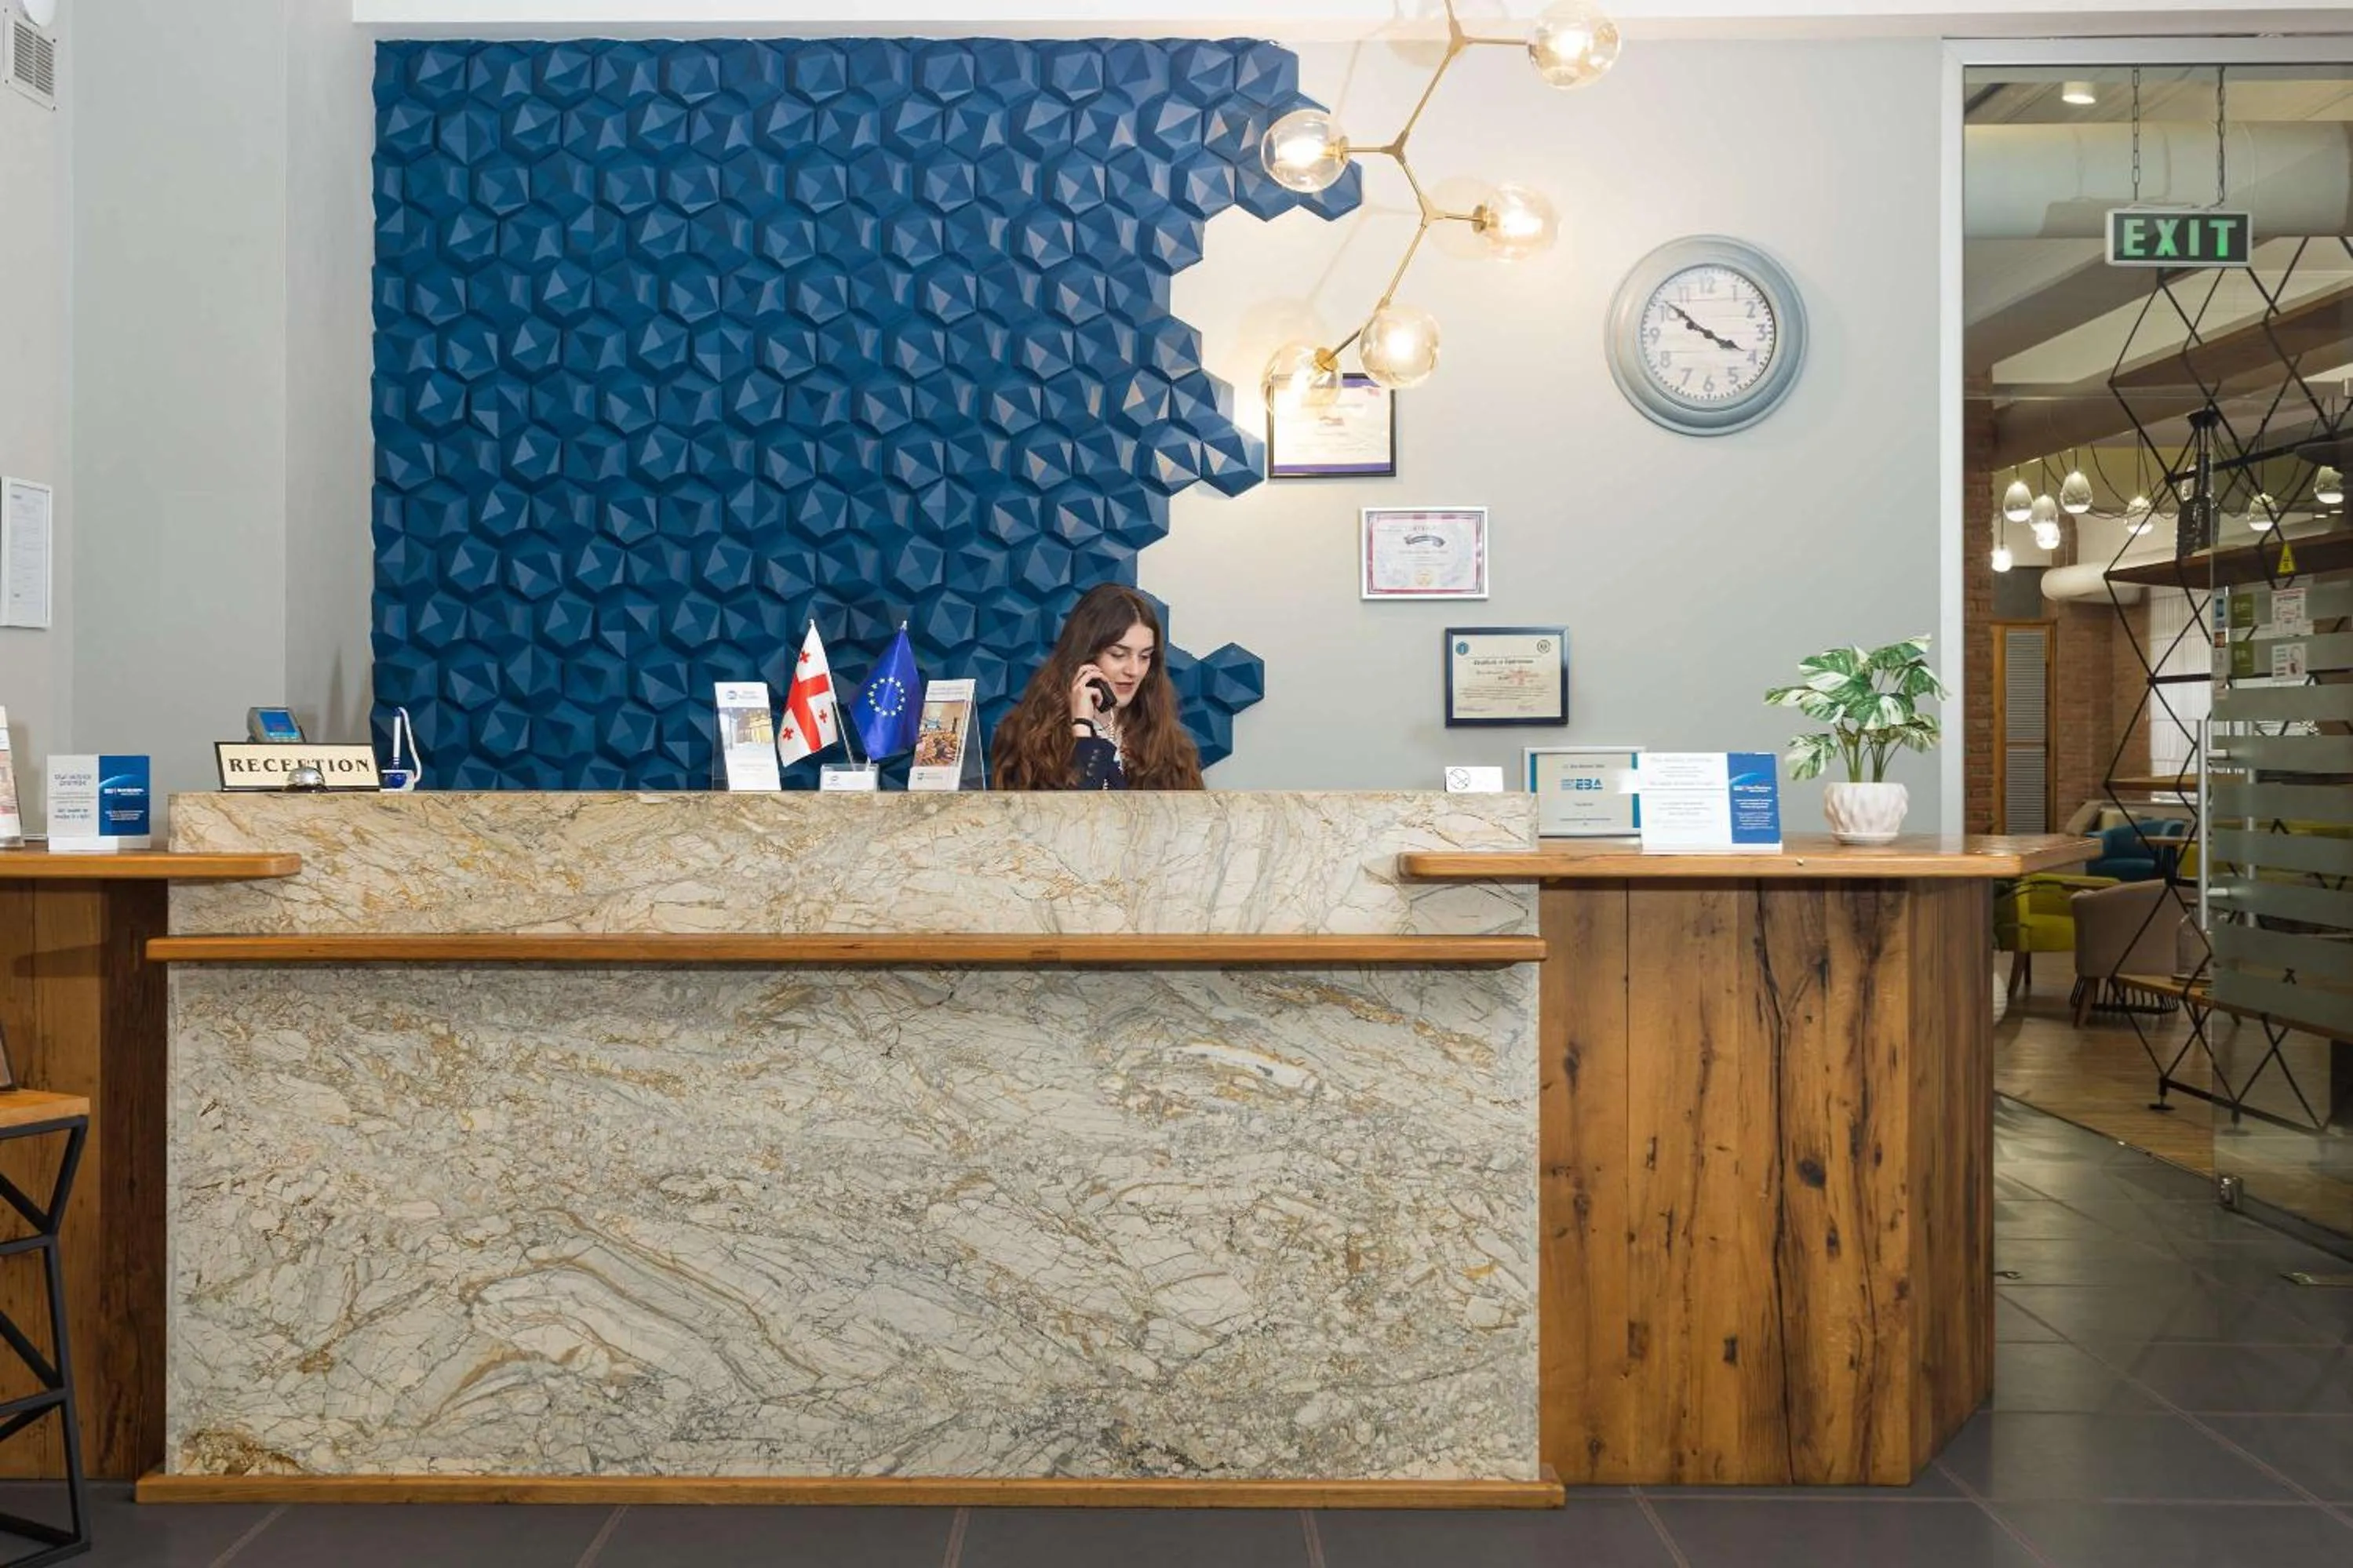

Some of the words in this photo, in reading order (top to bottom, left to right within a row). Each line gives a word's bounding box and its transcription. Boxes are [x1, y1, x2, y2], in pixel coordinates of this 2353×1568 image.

[2122, 219, 2237, 257] EXIT
[1699, 276, 1716, 294] 12
[1731, 284, 1738, 302] 1
[1678, 286, 1690, 304] 11
[1746, 300, 1756, 319] 2
[1649, 326, 1661, 344] 9
[1756, 323, 1766, 342] 3
[1659, 351, 1671, 369] 8
[1747, 348, 1757, 366] 4
[1680, 367, 1692, 386] 7
[1728, 366, 1739, 384] 5
[1703, 376, 1714, 393] 6
[228, 758, 370, 773] RECEPTION
